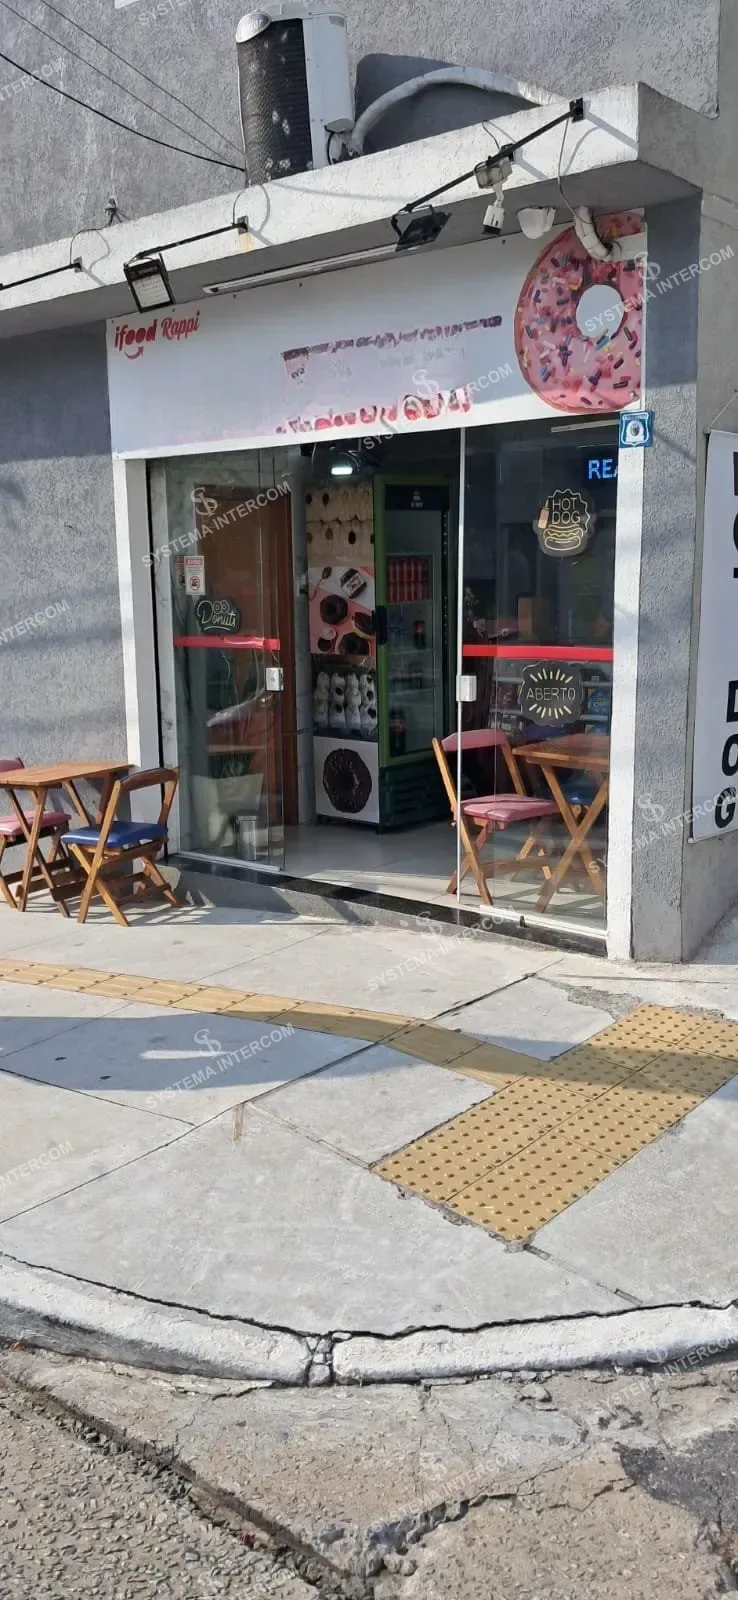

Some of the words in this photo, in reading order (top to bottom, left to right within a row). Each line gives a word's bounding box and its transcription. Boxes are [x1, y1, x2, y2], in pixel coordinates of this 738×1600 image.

[115, 319, 157, 351] ifood
[161, 310, 200, 340] Rappi
[588, 459, 618, 480] RE
[553, 498, 577, 511] HOT
[552, 511, 581, 525] DOG
[197, 600, 236, 628] Donuts
[527, 687, 576, 701] ABERTO
